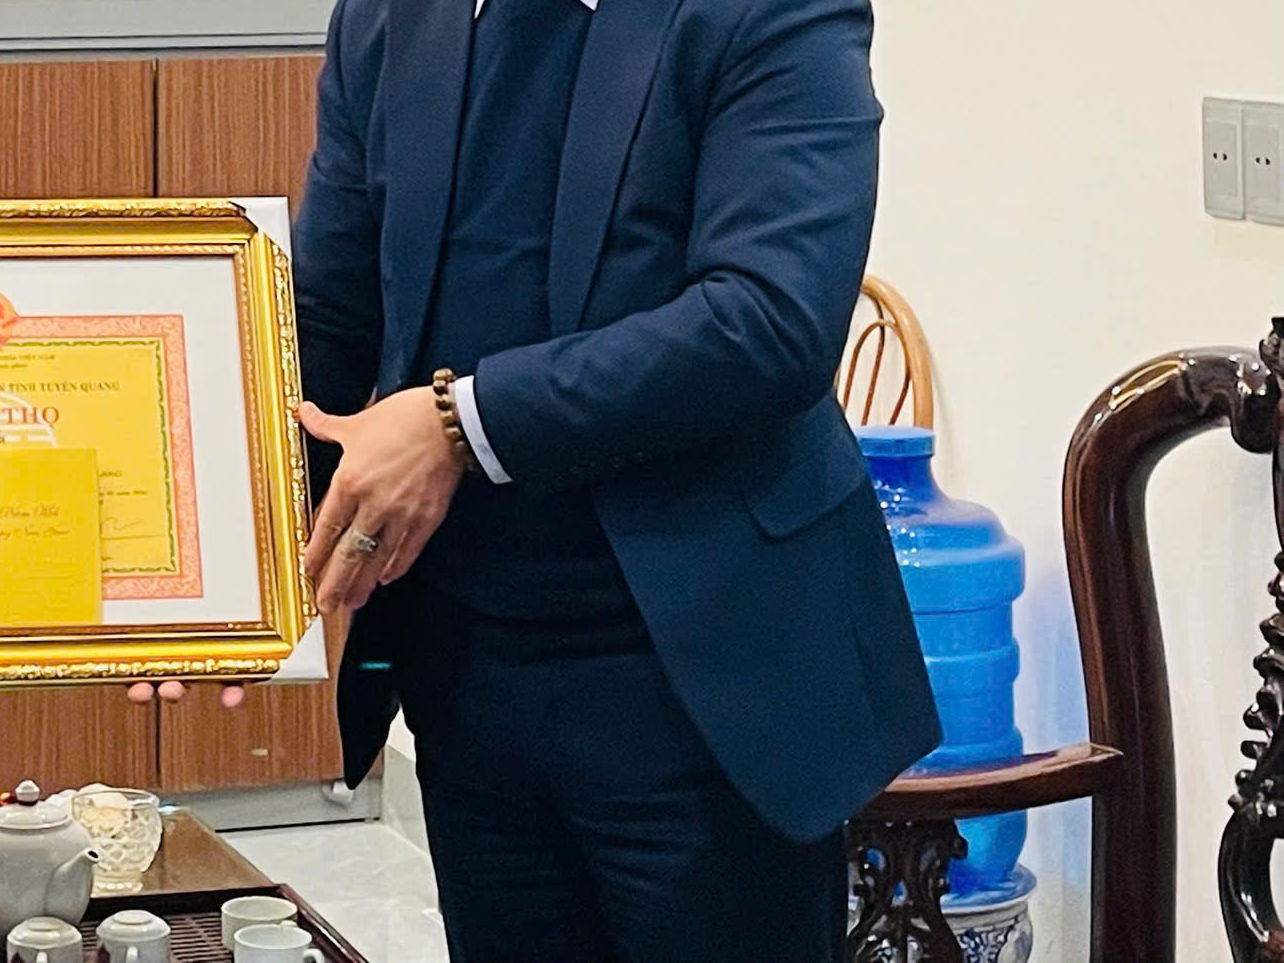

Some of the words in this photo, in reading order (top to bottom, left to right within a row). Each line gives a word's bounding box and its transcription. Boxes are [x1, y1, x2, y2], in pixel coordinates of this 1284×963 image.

[8, 380, 36, 392] TỈNH
[40, 379, 77, 392] TUYÊN
[79, 380, 121, 393] QUANG
[1, 405, 61, 428] THỌ
